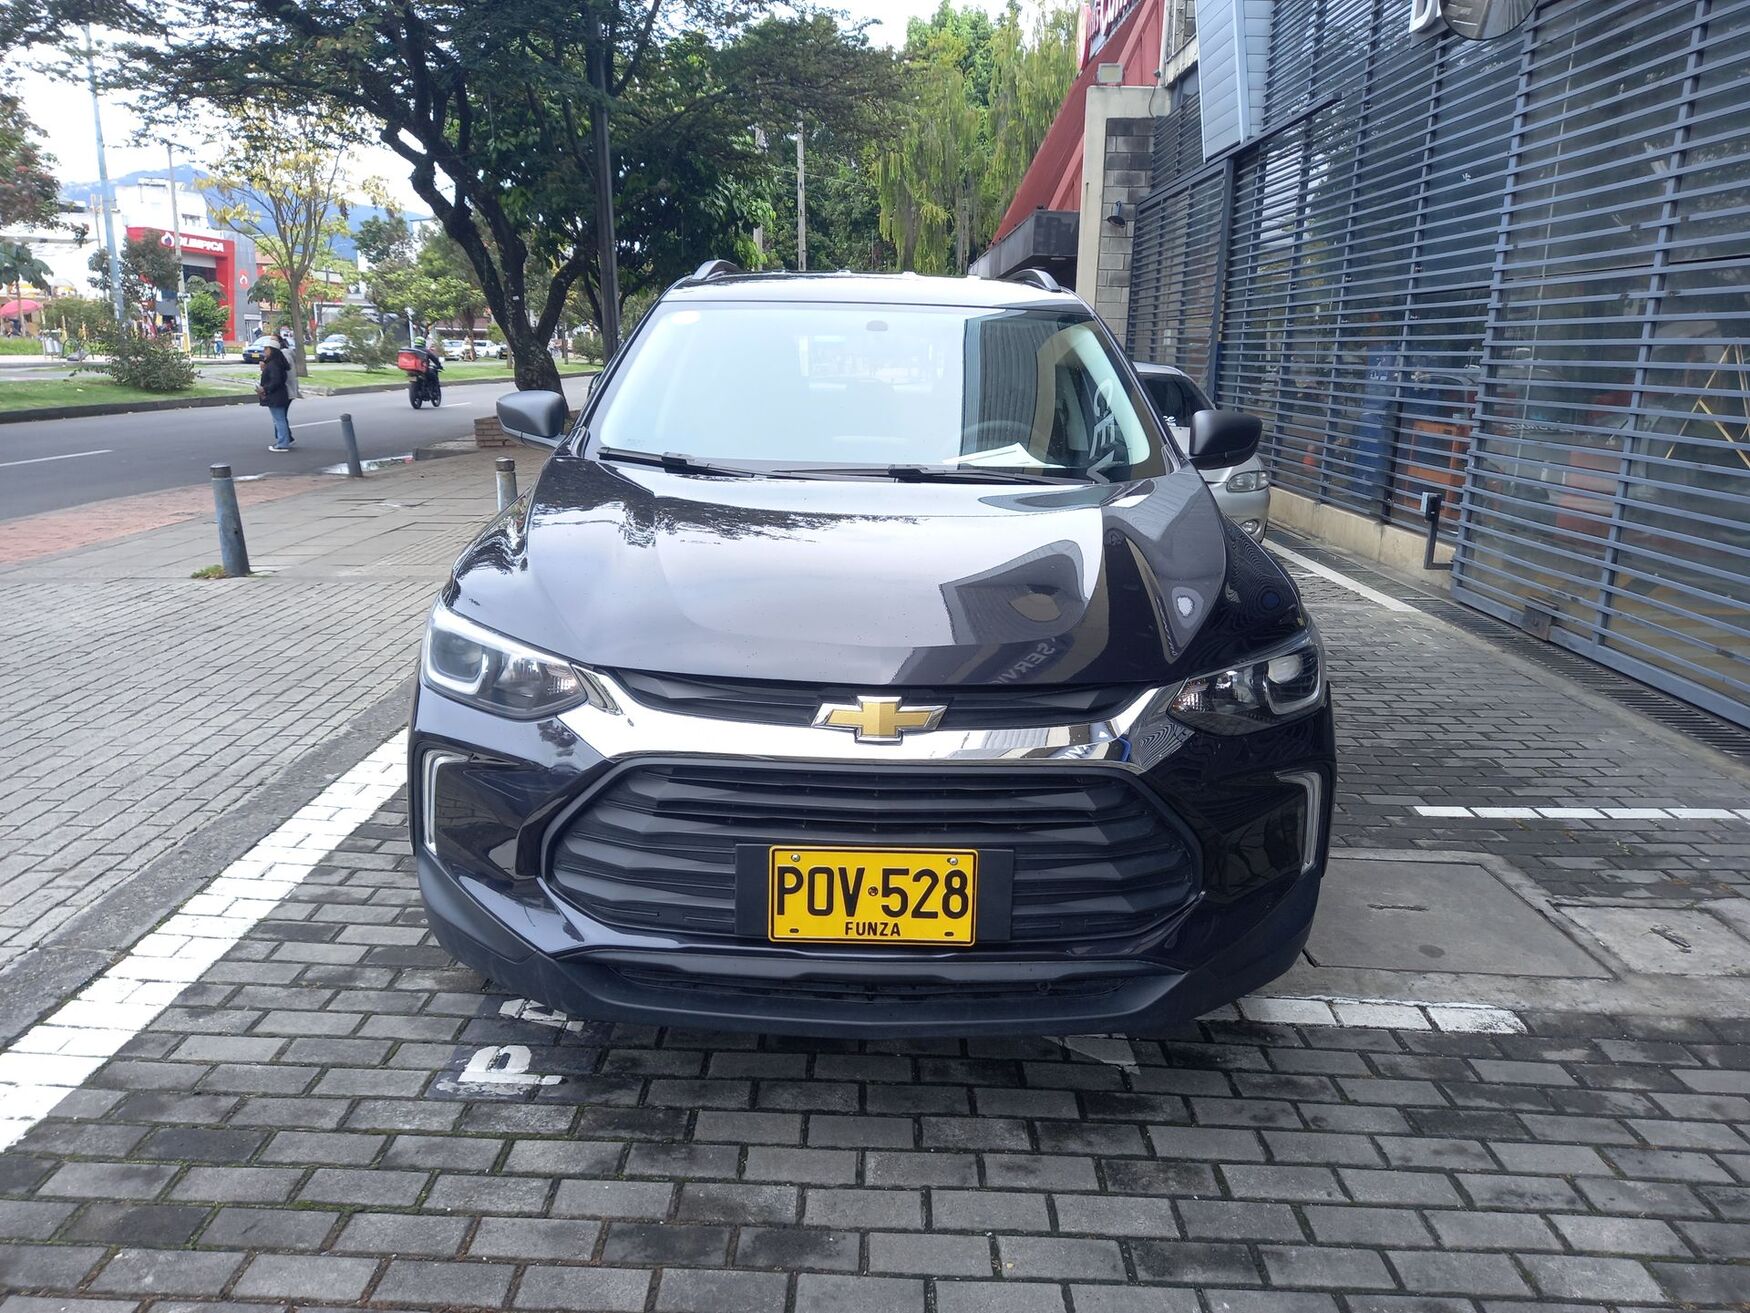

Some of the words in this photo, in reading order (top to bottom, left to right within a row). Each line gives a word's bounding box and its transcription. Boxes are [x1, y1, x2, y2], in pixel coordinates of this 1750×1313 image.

[776, 866, 865, 917] POV
[881, 867, 969, 920] 528
[844, 921, 901, 937] FUNZA
